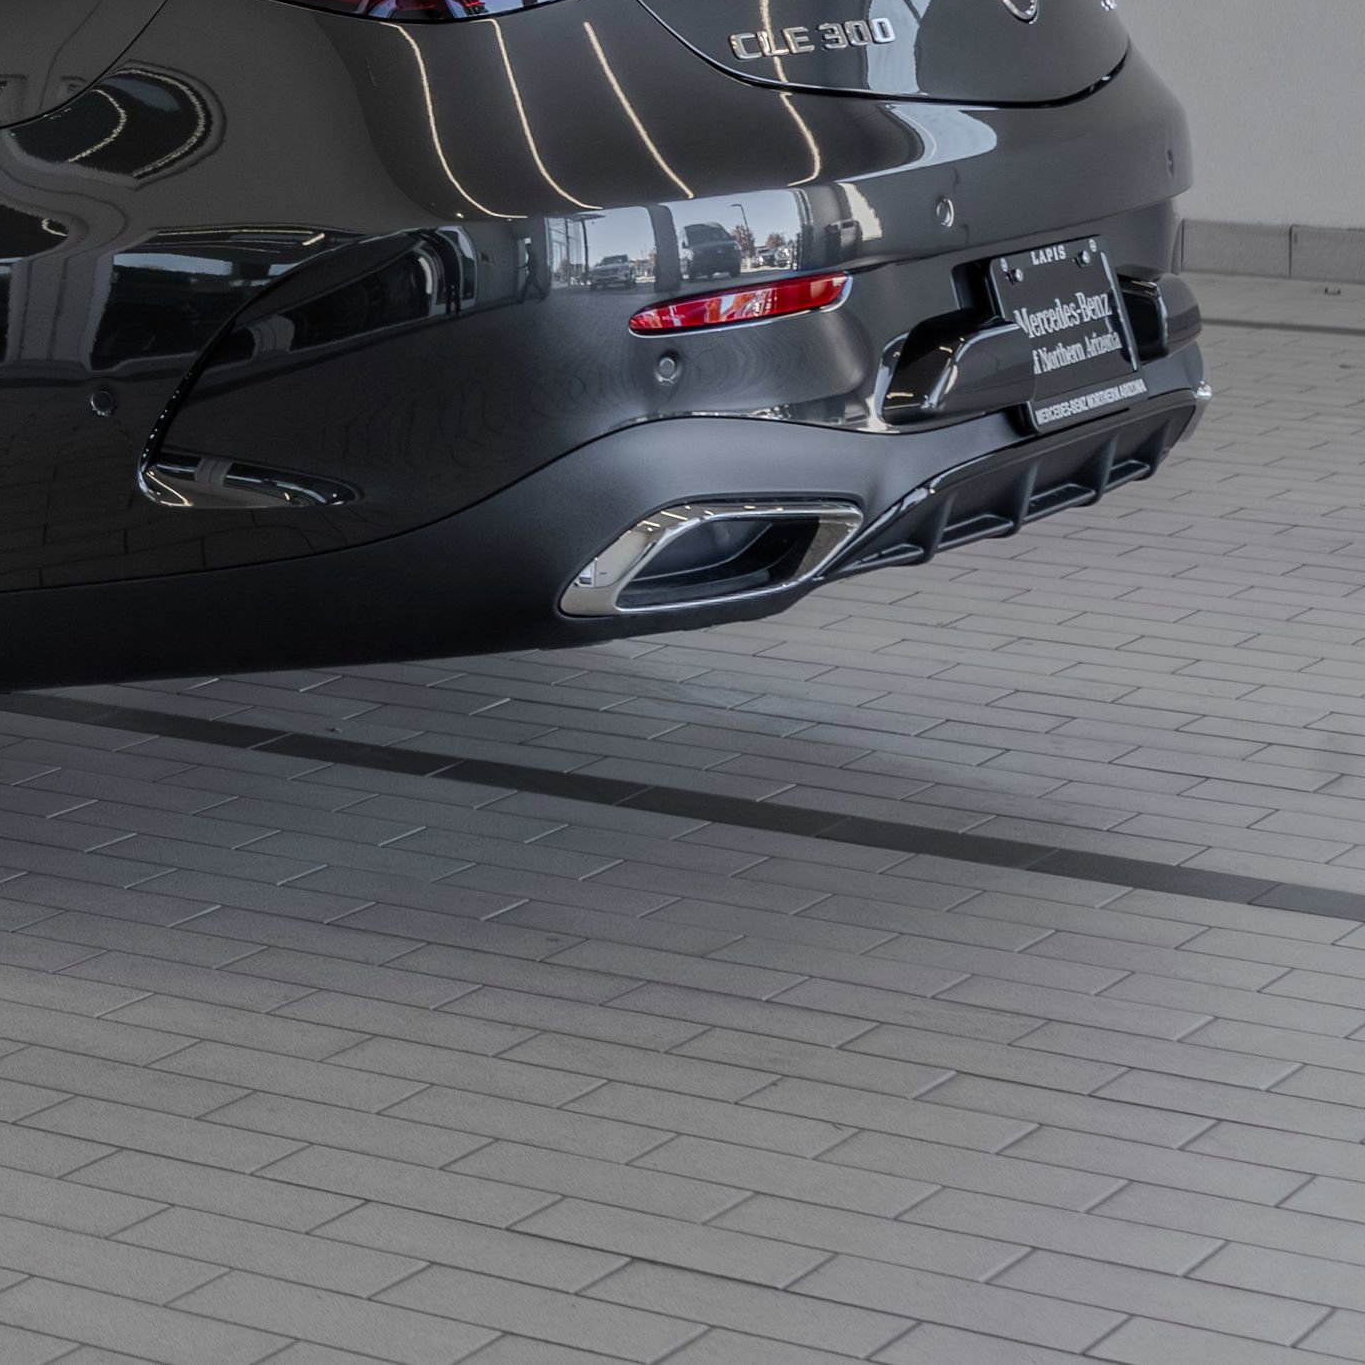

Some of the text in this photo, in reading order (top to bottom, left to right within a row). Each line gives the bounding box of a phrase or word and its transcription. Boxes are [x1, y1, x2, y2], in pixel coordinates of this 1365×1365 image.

[730, 17, 896, 61] CLE 300
[1030, 244, 1067, 265] LAPIS
[1013, 291, 1113, 338] Mercedes-Benz
[1038, 342, 1086, 372] Northern
[1084, 332, 1123, 358] Arizona
[1035, 396, 1089, 425] MERCEDES-BENZ
